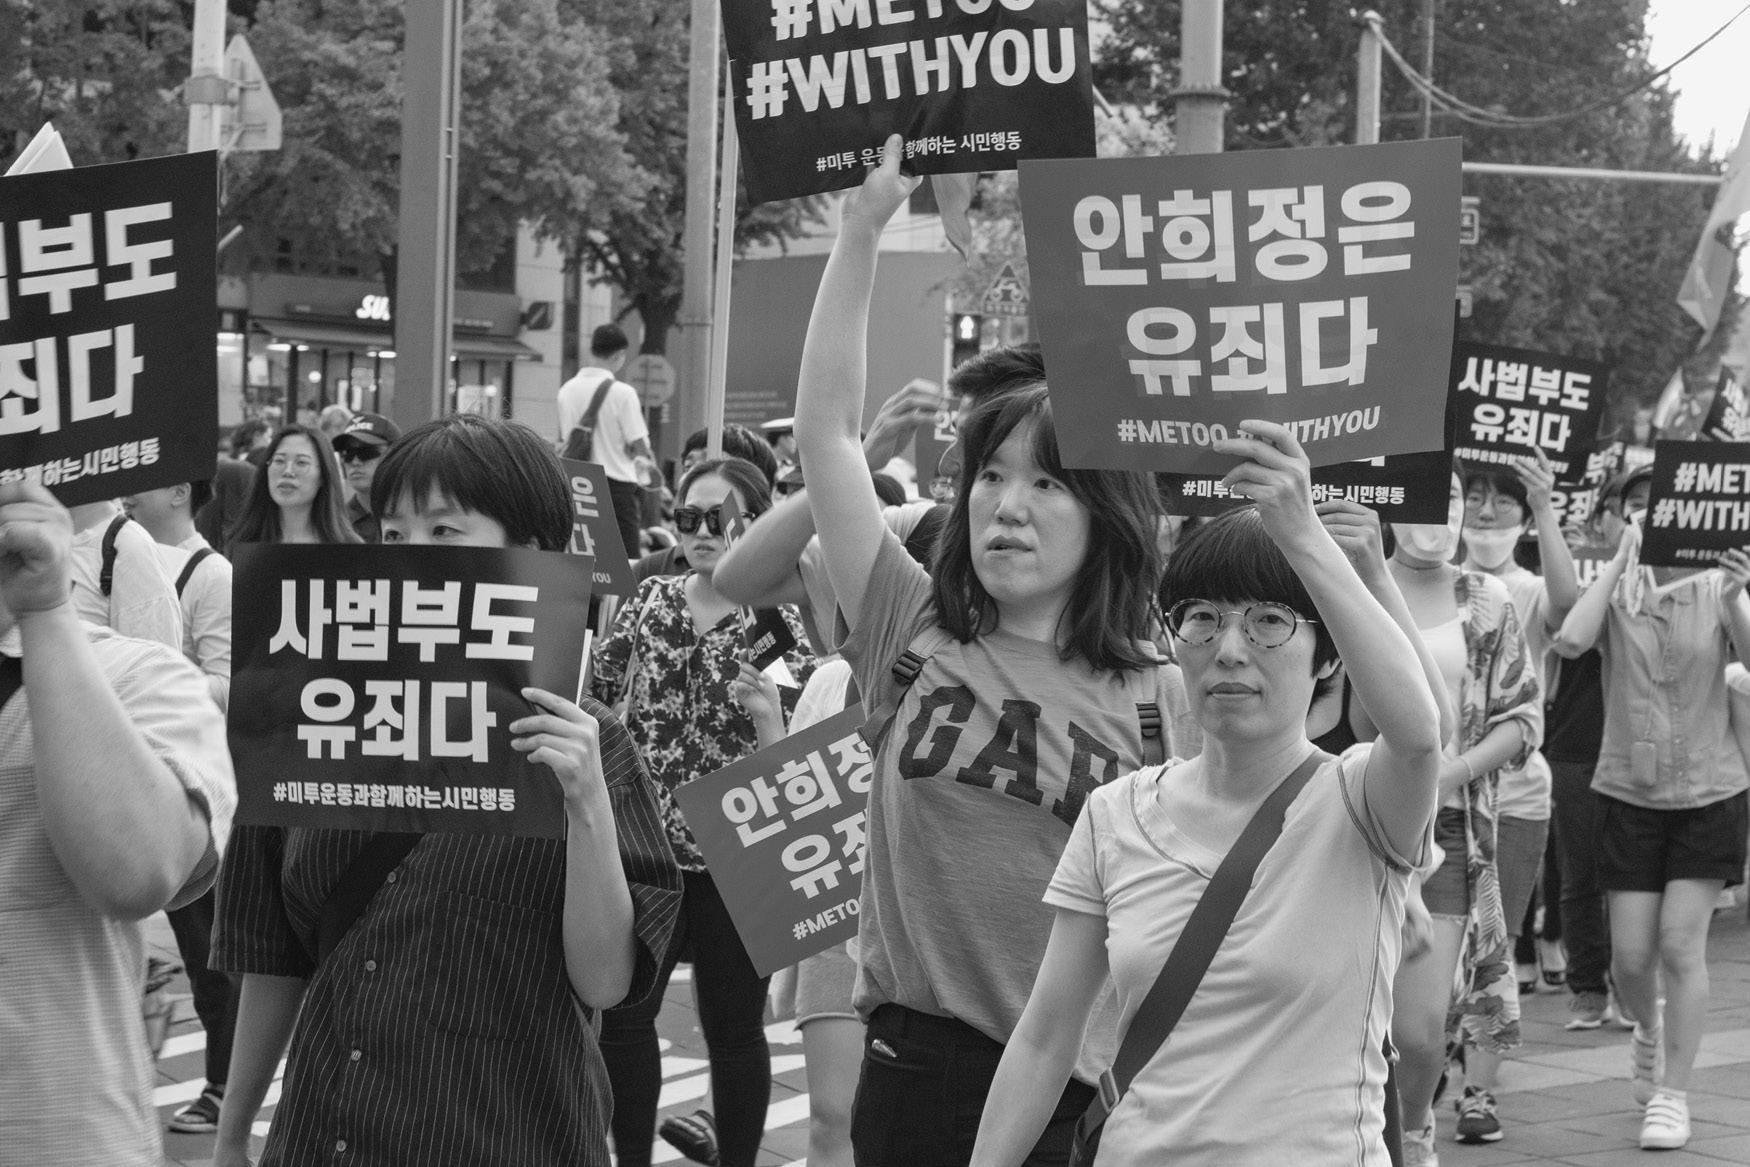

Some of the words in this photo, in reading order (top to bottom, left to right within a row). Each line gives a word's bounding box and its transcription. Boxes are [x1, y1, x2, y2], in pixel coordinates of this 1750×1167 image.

[746, 27, 1076, 120] #WITHYOU
[816, 151, 857, 172] #미투
[860, 136, 957, 169] 운동함께하는
[960, 130, 1022, 153] 시민행동
[0, 201, 177, 315] 부도
[1073, 180, 1415, 286] 안희정은
[1126, 295, 1379, 396] 유죄다
[1457, 356, 1593, 412] 사법부도
[1117, 409, 1228, 446] #METOO
[1470, 402, 1572, 453] 유죄다
[1652, 498, 1750, 532] #WITH
[269, 578, 539, 662] 사법부도
[297, 677, 497, 763] 유죄다
[898, 684, 1119, 830] GAP
[273, 781, 516, 812] #미투운동과함께하는시민행동
